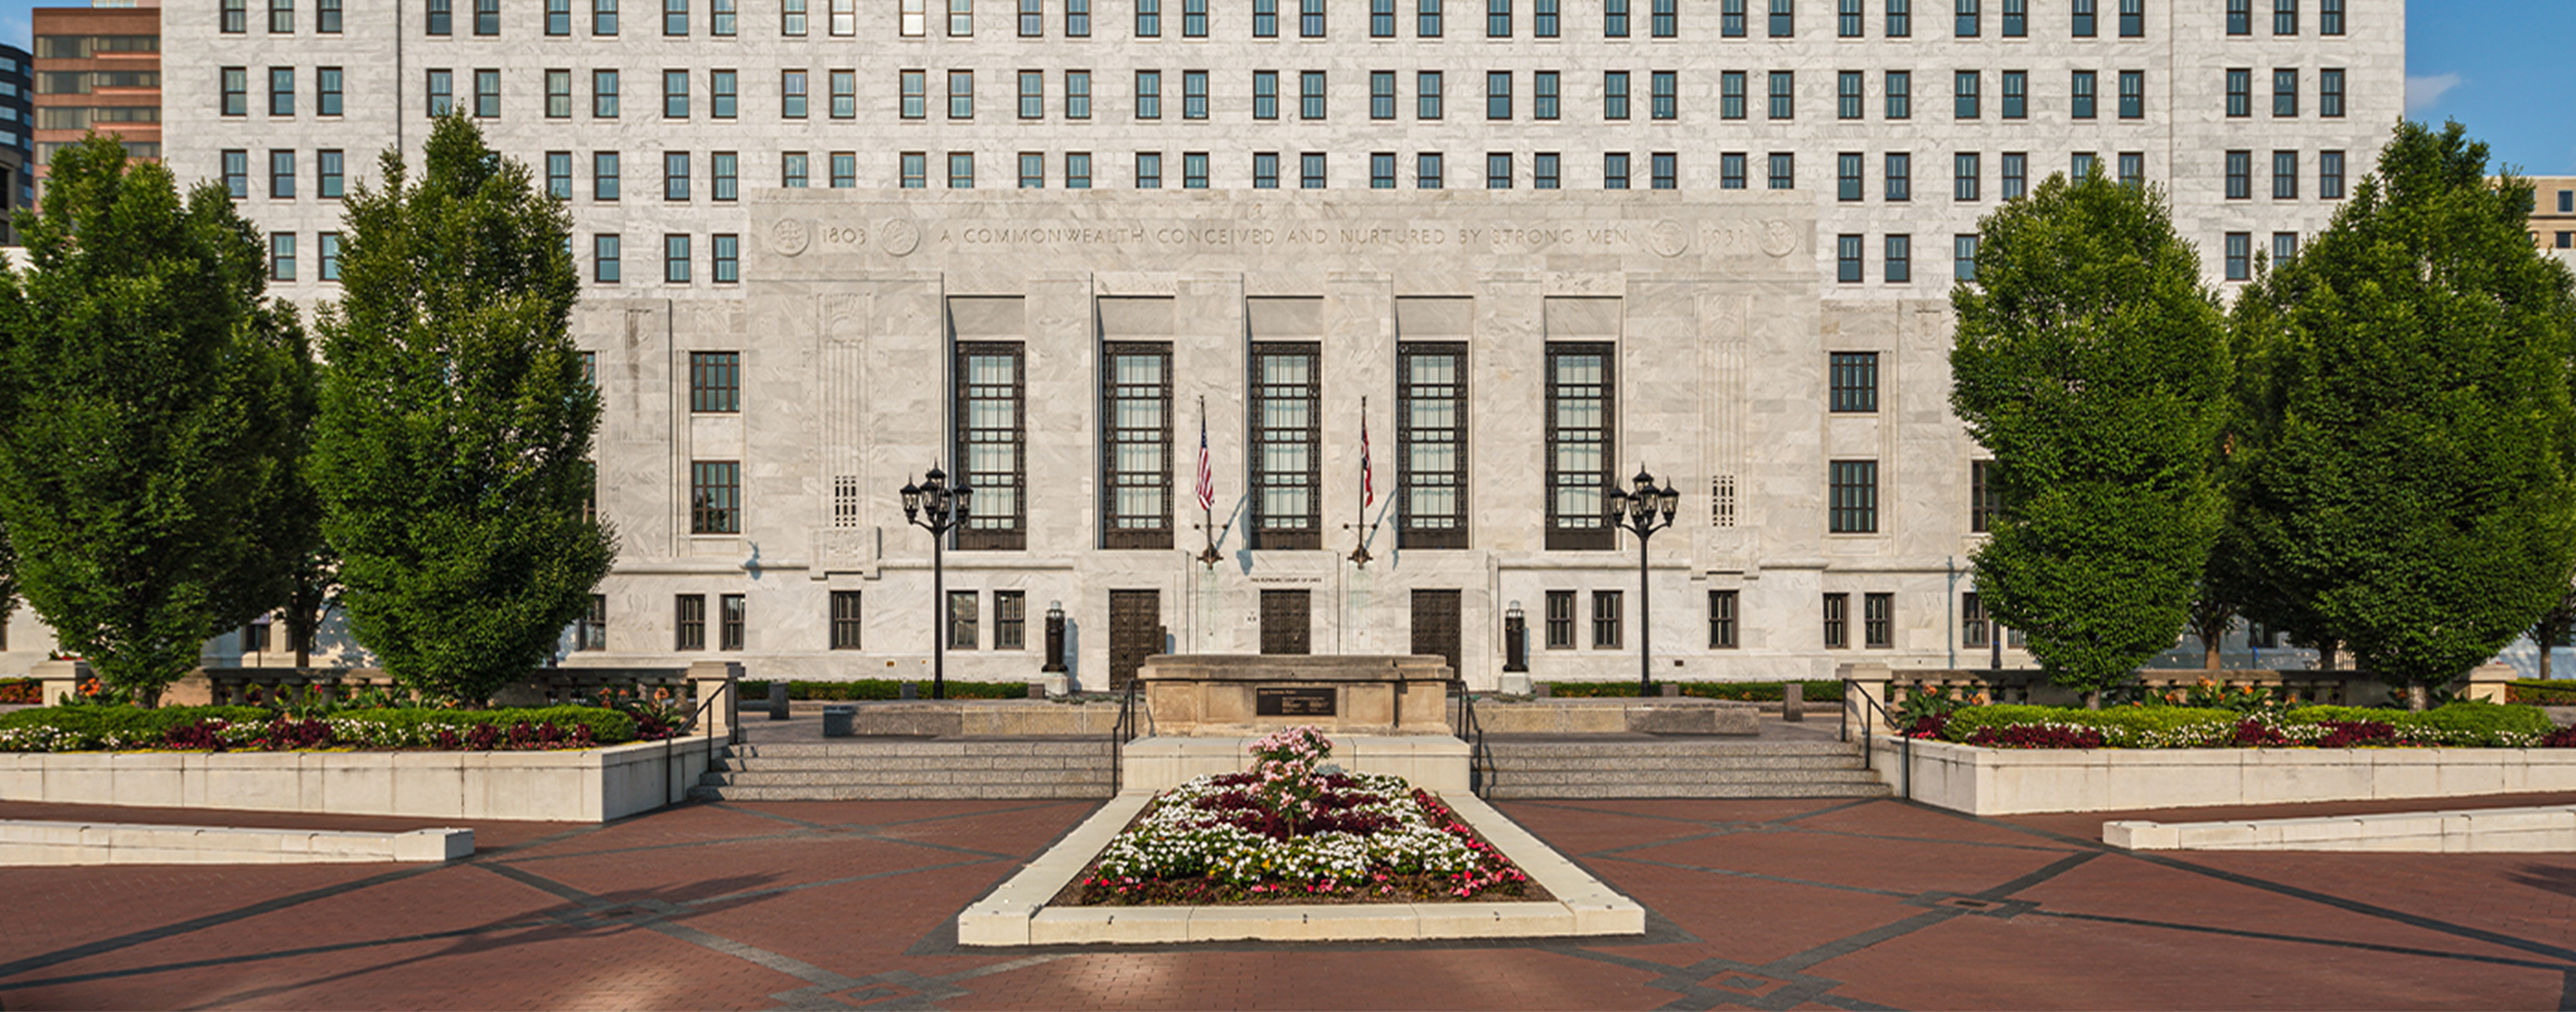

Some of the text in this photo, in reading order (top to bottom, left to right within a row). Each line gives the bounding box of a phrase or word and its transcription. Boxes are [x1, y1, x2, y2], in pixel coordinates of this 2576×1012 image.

[823, 226, 867, 246] 1803
[939, 228, 1627, 246] A COMMONWEALTH CONCEIVED AND NURTURED BY STRONG MEN
[1702, 228, 1743, 247] 1931
